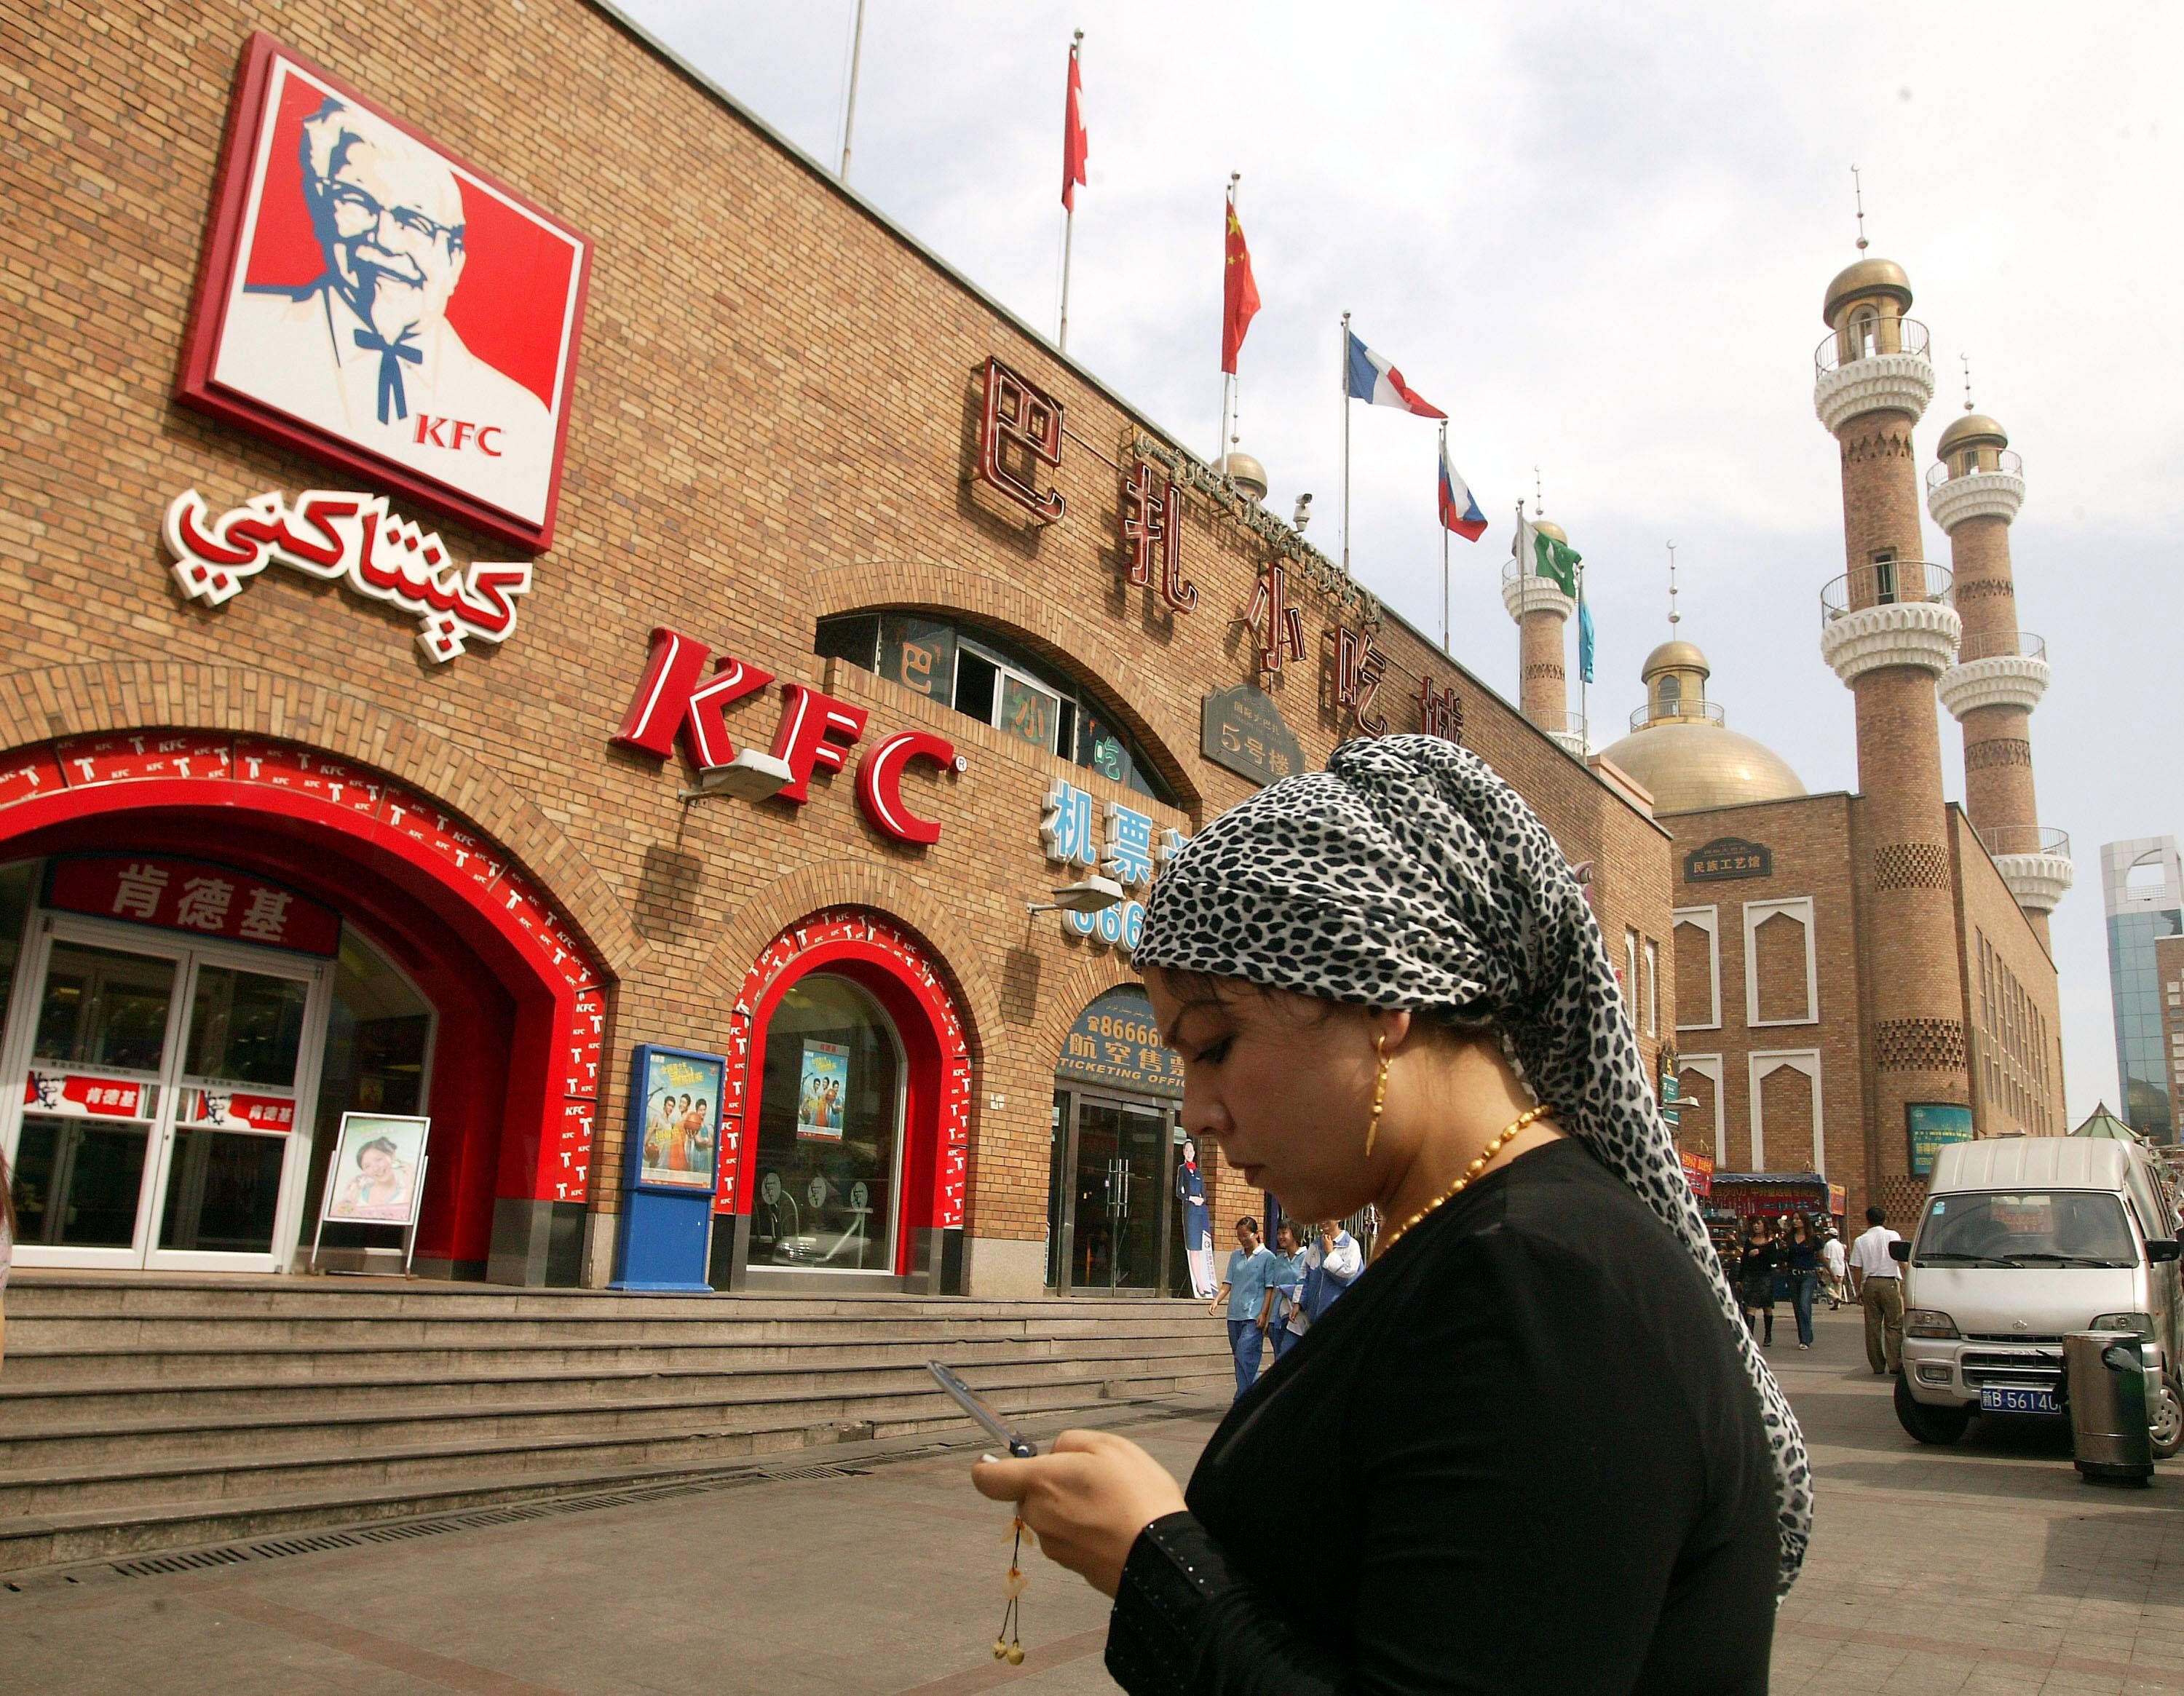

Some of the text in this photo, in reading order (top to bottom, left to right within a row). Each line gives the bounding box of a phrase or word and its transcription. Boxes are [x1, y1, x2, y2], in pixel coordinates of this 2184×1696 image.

[413, 413, 502, 457] KFC
[610, 627, 956, 845] KFC
[159, 739, 186, 753] KFC
[146, 761, 165, 772] KFC
[320, 765, 345, 776] KFC
[111, 769, 130, 779] KFC
[208, 769, 225, 778] KFC
[272, 777, 290, 785] KFC
[304, 780, 320, 788] KFC
[408, 829, 424, 840] KFC
[453, 831, 475, 847] KFC
[435, 840, 450, 850] KFC
[473, 874, 487, 884] KFC
[112, 863, 293, 943] 肯德基
[519, 916, 532, 929] KFC
[539, 934, 552, 946] KFC
[556, 932, 576, 949] KFC
[576, 1003, 596, 1013] KFC
[1100, 1015, 1169, 1051] 86666
[1060, 1058, 1142, 1080] TICKETING
[565, 1106, 586, 1116] KFC
[721, 1122, 733, 1130] FC
